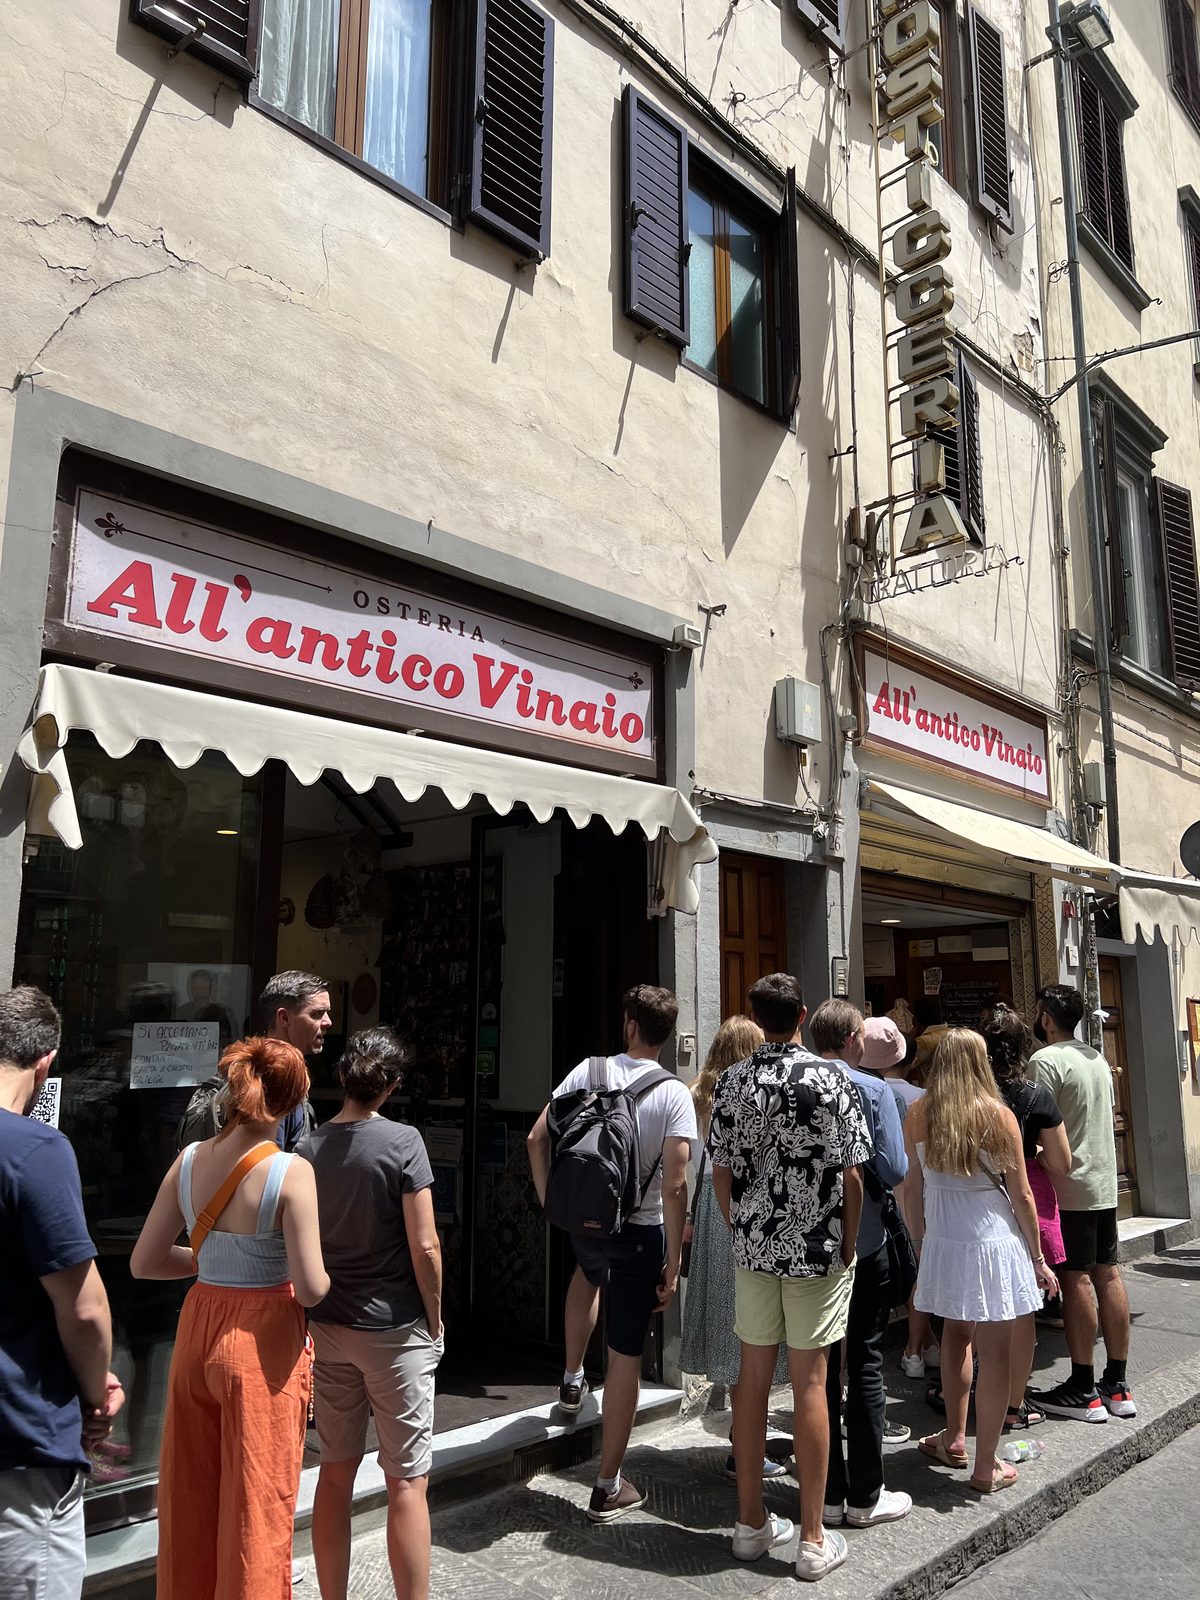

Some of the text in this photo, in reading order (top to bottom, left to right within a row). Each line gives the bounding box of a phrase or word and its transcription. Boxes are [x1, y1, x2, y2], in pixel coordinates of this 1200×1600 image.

[881, 0, 968, 555] OSTICCERIA
[86, 560, 645, 745] All'antico Vinaio
[353, 590, 485, 643] OSTERIA
[872, 681, 1043, 776] All'antico Vinaio
[828, 834, 841, 851] 26
